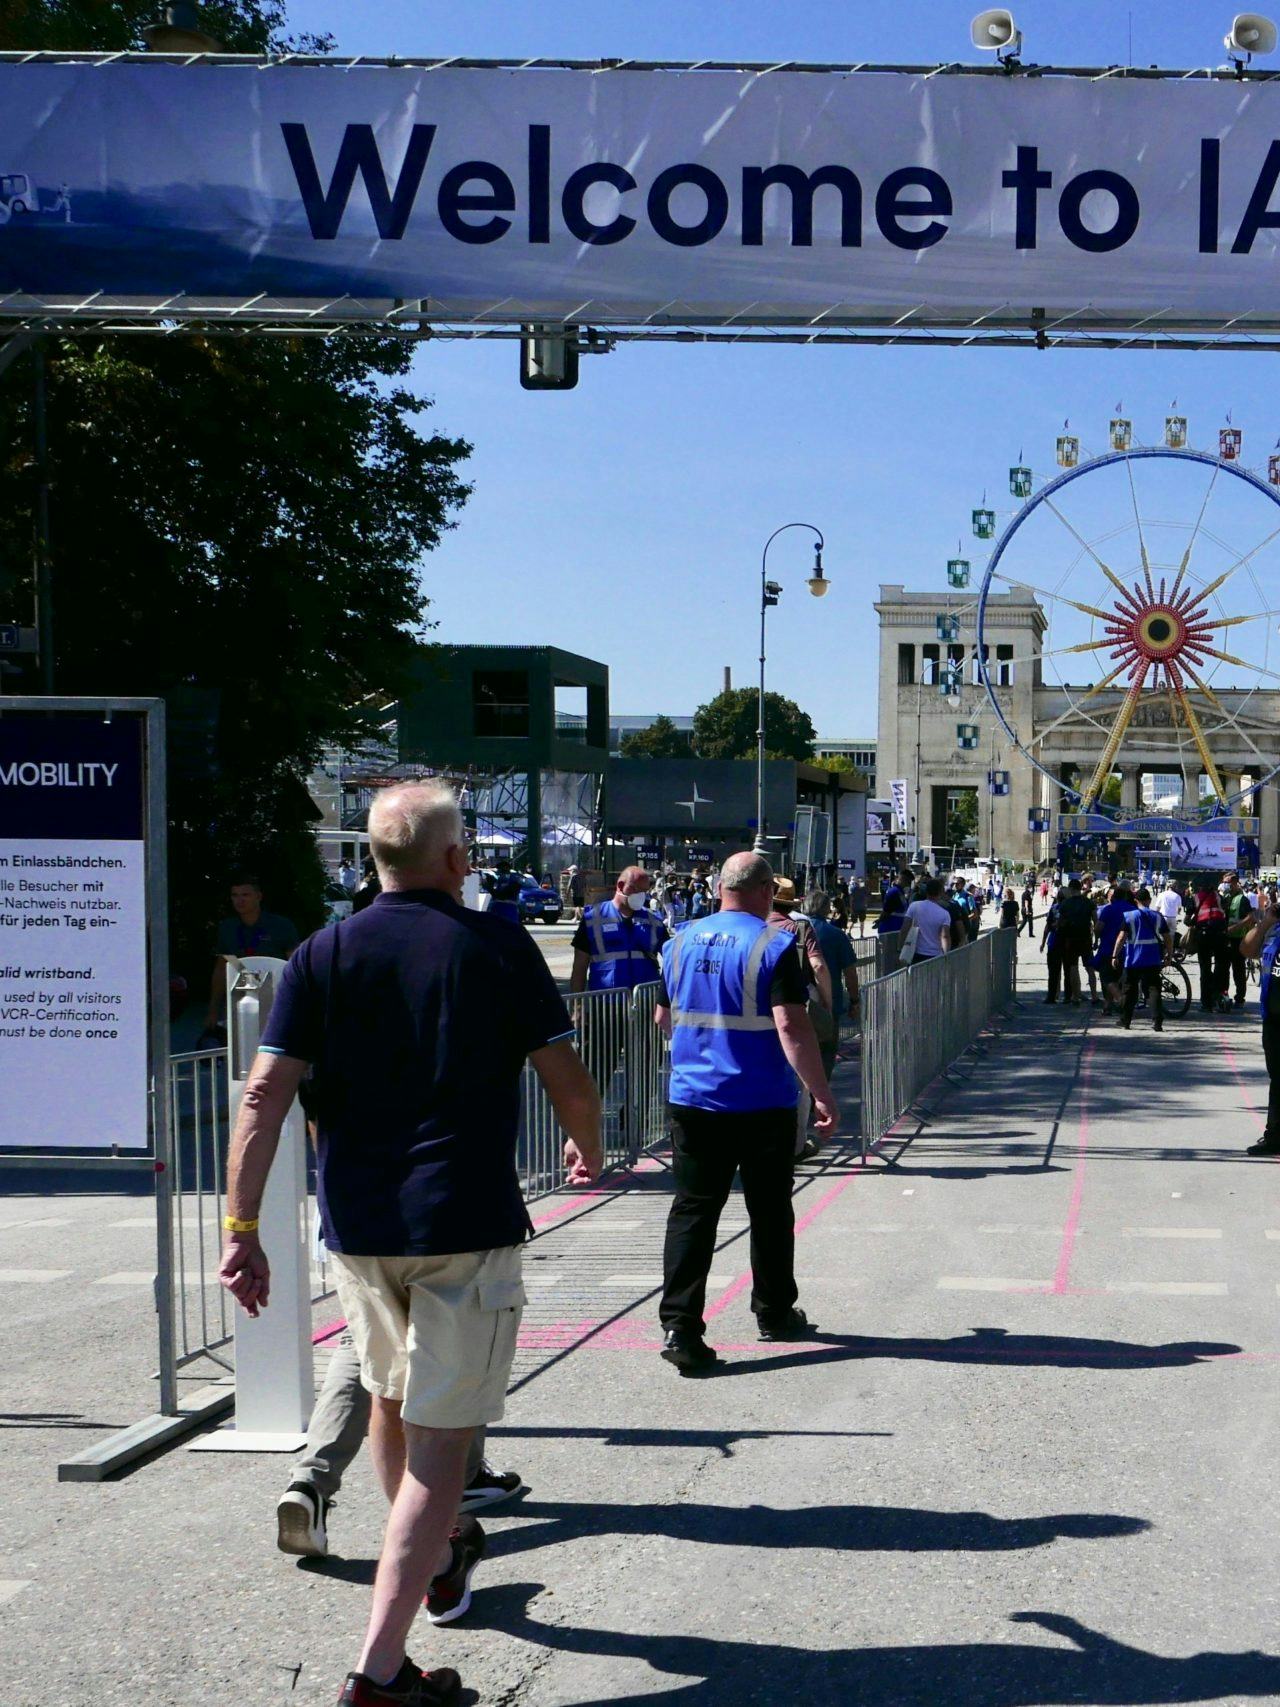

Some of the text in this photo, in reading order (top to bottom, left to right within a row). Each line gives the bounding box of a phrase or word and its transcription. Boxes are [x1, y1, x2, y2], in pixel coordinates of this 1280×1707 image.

[281, 122, 953, 250] Welcome
[1001, 144, 1141, 253] to
[0, 762, 119, 787] MOBILITY
[13, 855, 126, 868] Einlassbändchen.
[19, 880, 78, 892] Besucher
[83, 881, 103, 892] mit
[70, 899, 121, 910] nutzbar.
[0, 915, 117, 930] für jeden Tag ein-
[691, 932, 739, 950] SECURITY
[24, 967, 95, 980] wristband.
[695, 959, 721, 975] 2305
[4, 992, 121, 1006] used by all visitors
[1, 1008, 119, 1022] VCR-Certification.
[29, 1026, 46, 1038] be
[49, 1027, 81, 1038] done
[86, 1030, 118, 1039] once
